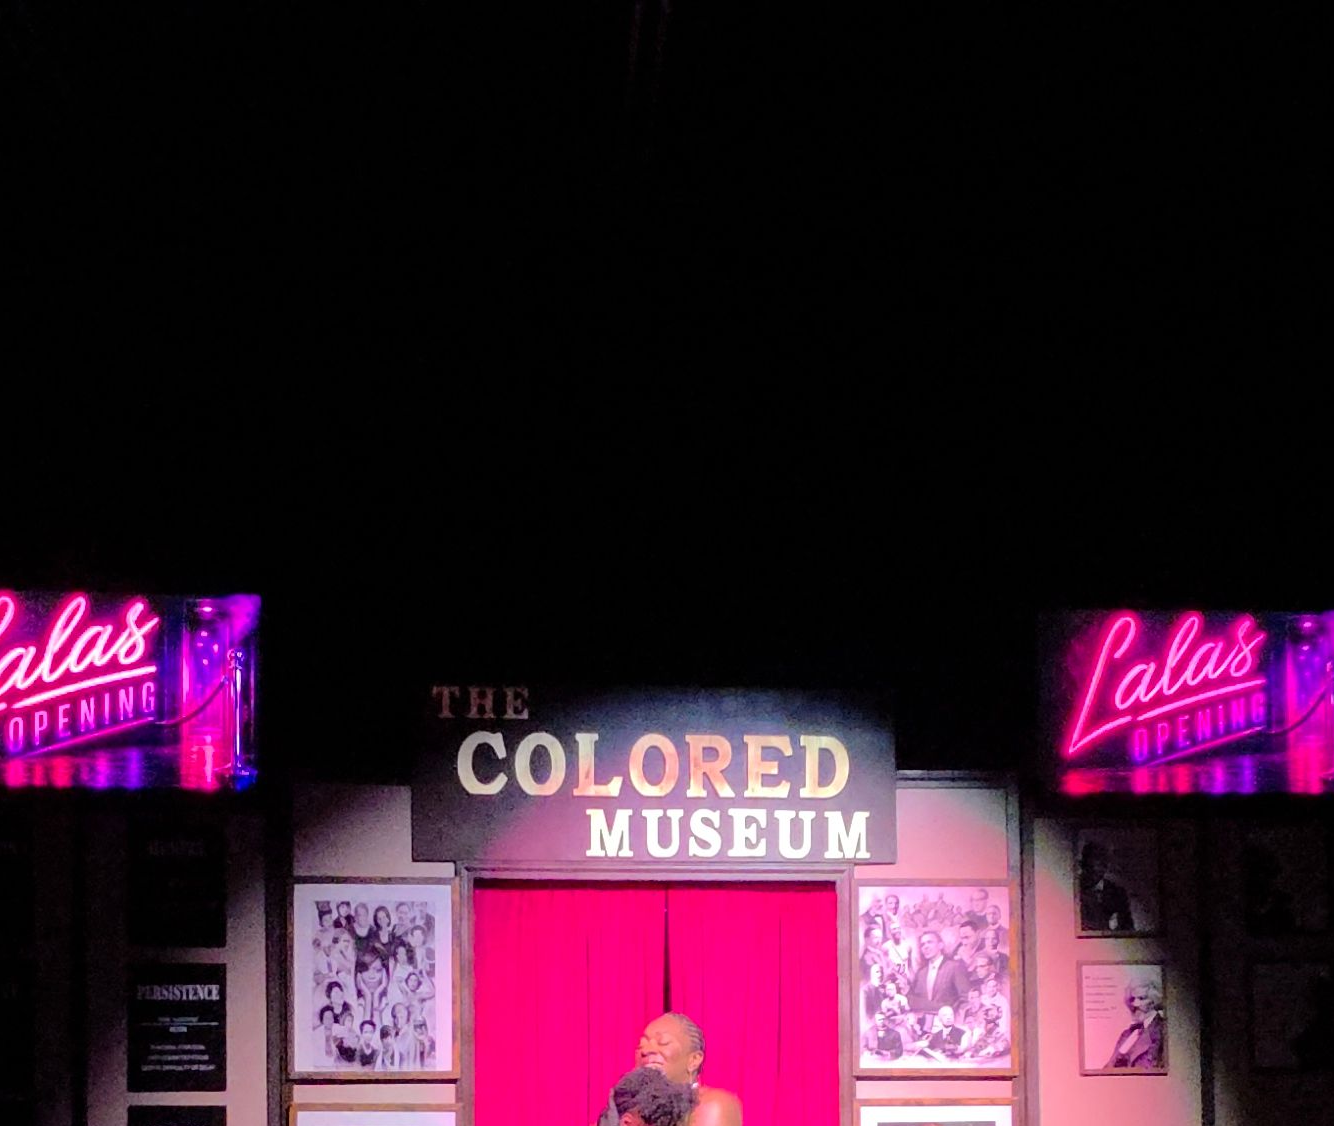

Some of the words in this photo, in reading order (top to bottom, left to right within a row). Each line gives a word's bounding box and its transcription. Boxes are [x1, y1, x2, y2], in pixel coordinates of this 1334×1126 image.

[8, 681, 156, 752] OPENING
[431, 684, 530, 720] THE
[1068, 614, 1267, 754] Lalas
[1133, 693, 1265, 762] OPENING
[456, 730, 851, 799] COLORED
[585, 807, 871, 860] MUSEUM
[136, 984, 220, 1001] PERSISTENCE
